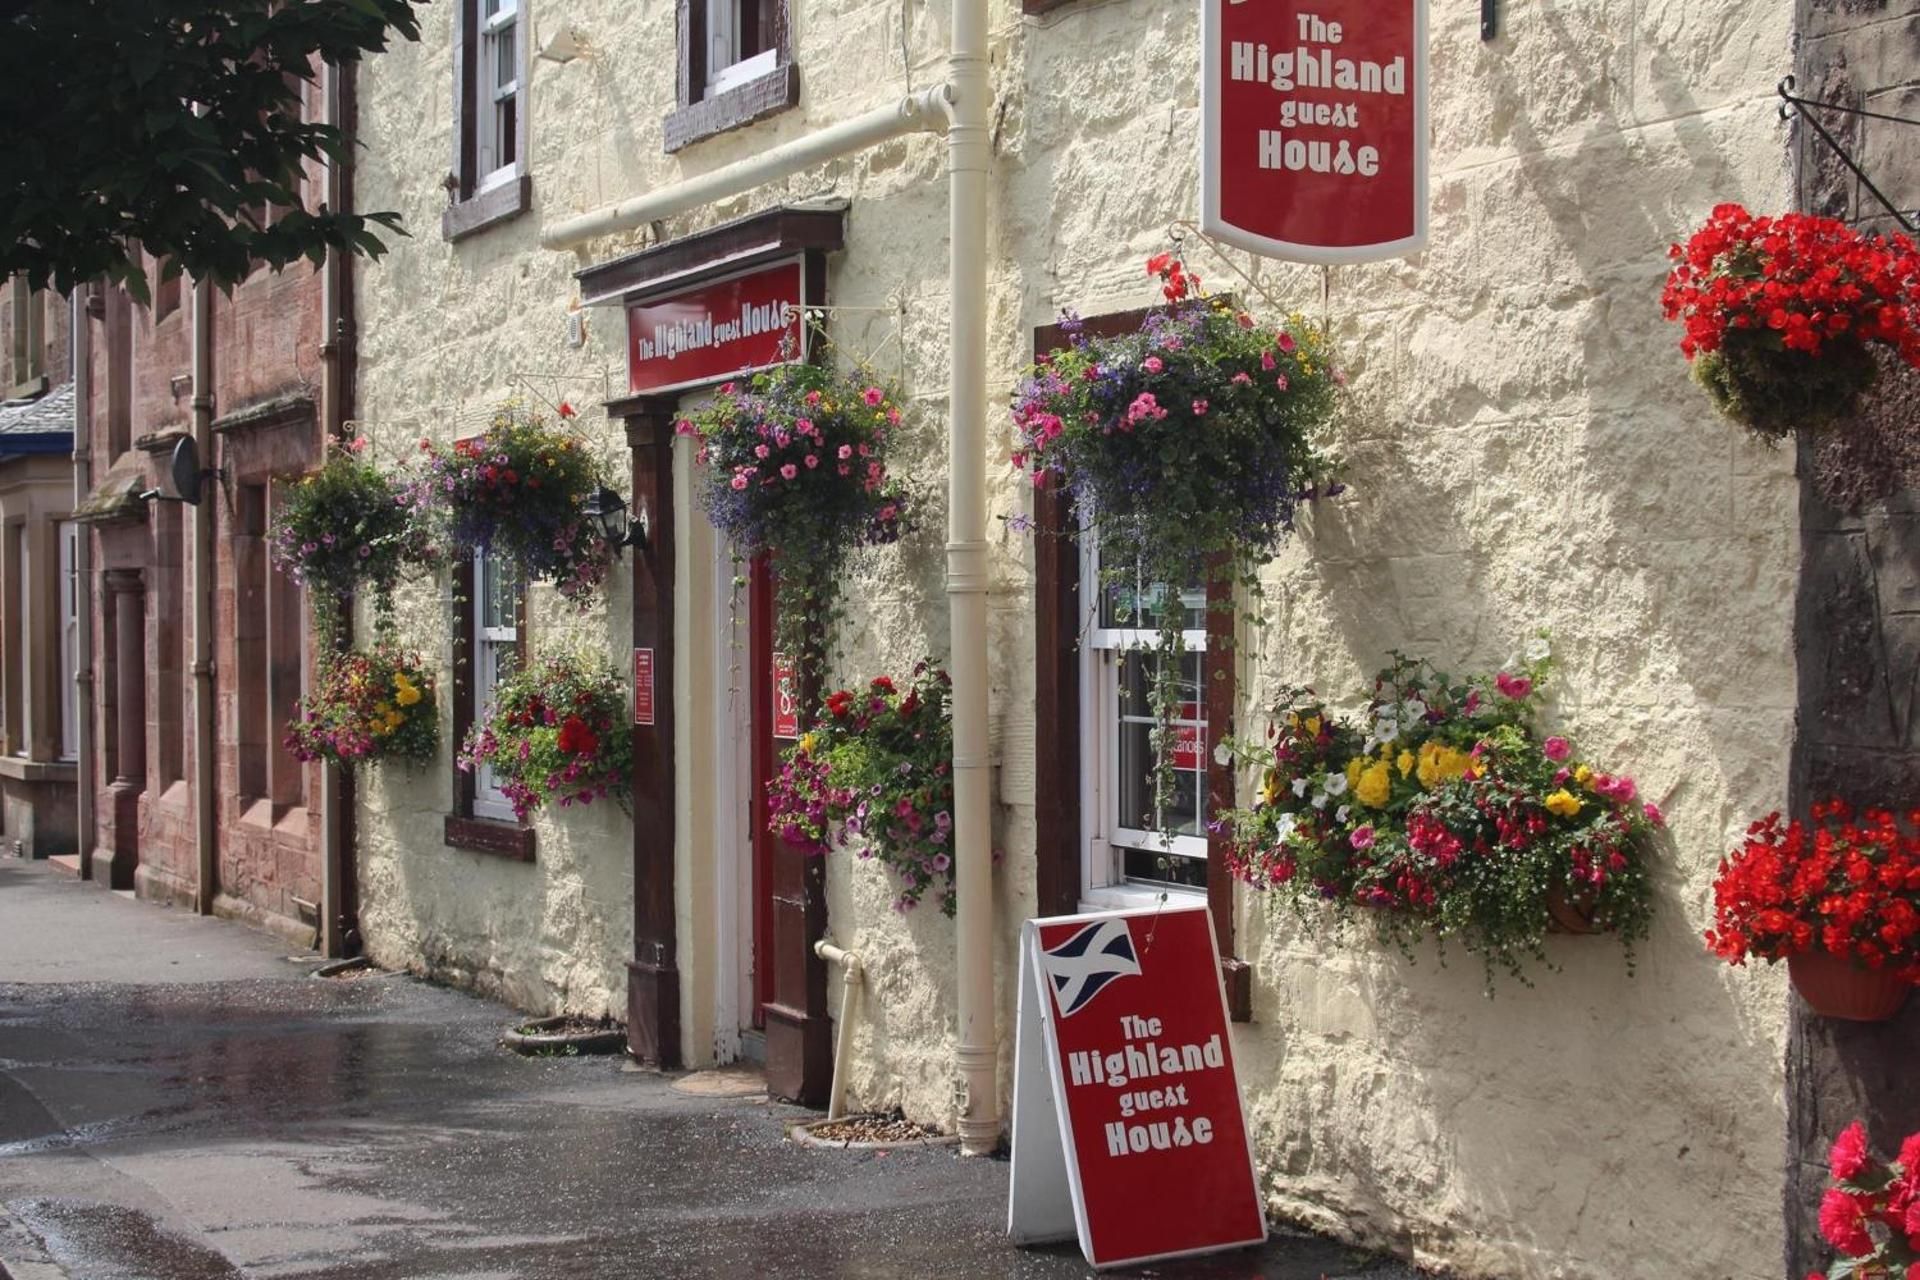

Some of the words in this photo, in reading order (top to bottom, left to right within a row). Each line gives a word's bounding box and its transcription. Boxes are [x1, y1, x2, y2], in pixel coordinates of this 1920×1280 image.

[1297, 13, 1343, 44] The
[1231, 41, 1405, 95] Highland
[1280, 100, 1359, 128] guest
[1258, 129, 1379, 176] House
[639, 337, 654, 360] The
[654, 312, 713, 360] Highland
[713, 318, 741, 348] guest
[742, 299, 789, 337] House
[1120, 1015, 1163, 1040] The
[1068, 1034, 1225, 1087] Highland
[1119, 1083, 1189, 1116] guest
[1105, 1116, 1213, 1157] House
